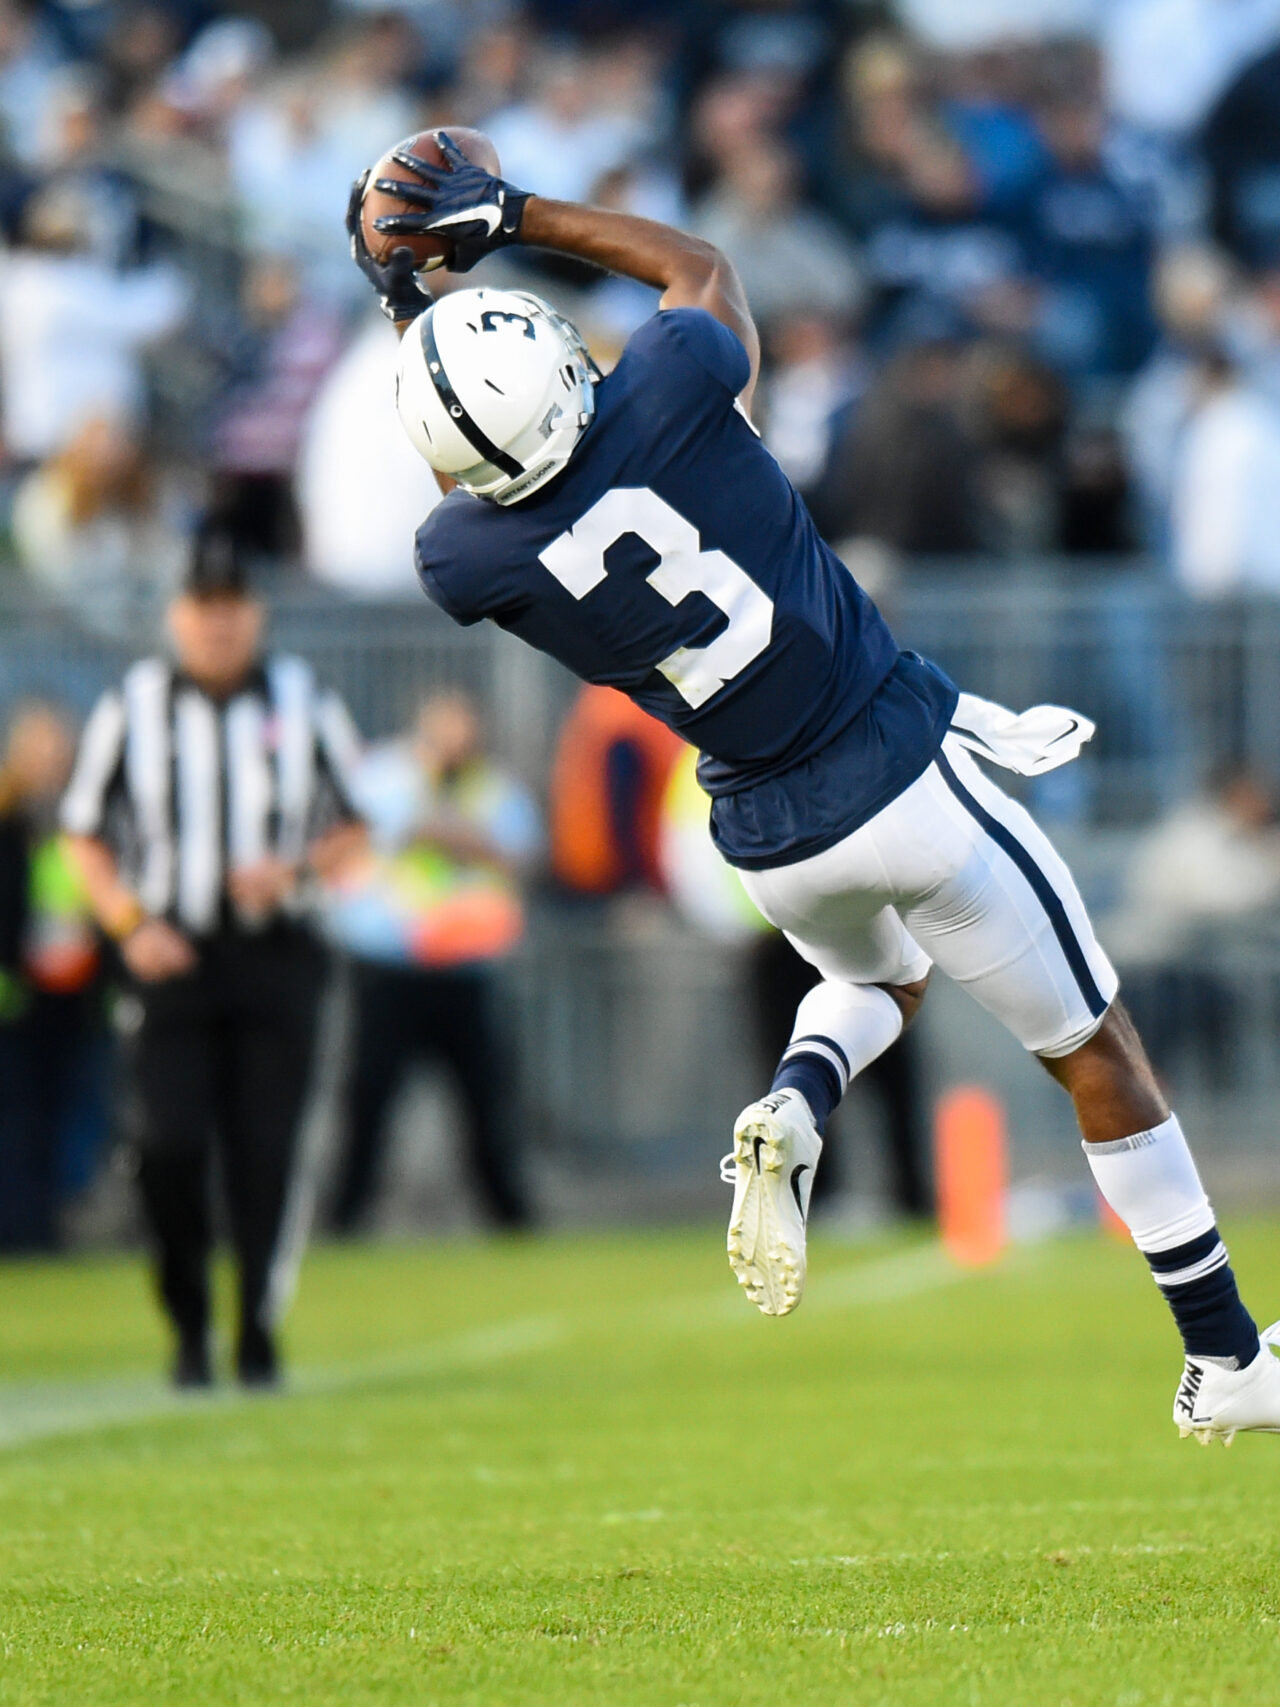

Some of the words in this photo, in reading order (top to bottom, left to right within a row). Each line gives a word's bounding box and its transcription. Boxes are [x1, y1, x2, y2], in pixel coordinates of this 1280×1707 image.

[481, 310, 536, 341] 3
[531, 460, 556, 482] LIONS
[537, 486, 774, 710] 3
[1176, 1361, 1204, 1419] NIKE
